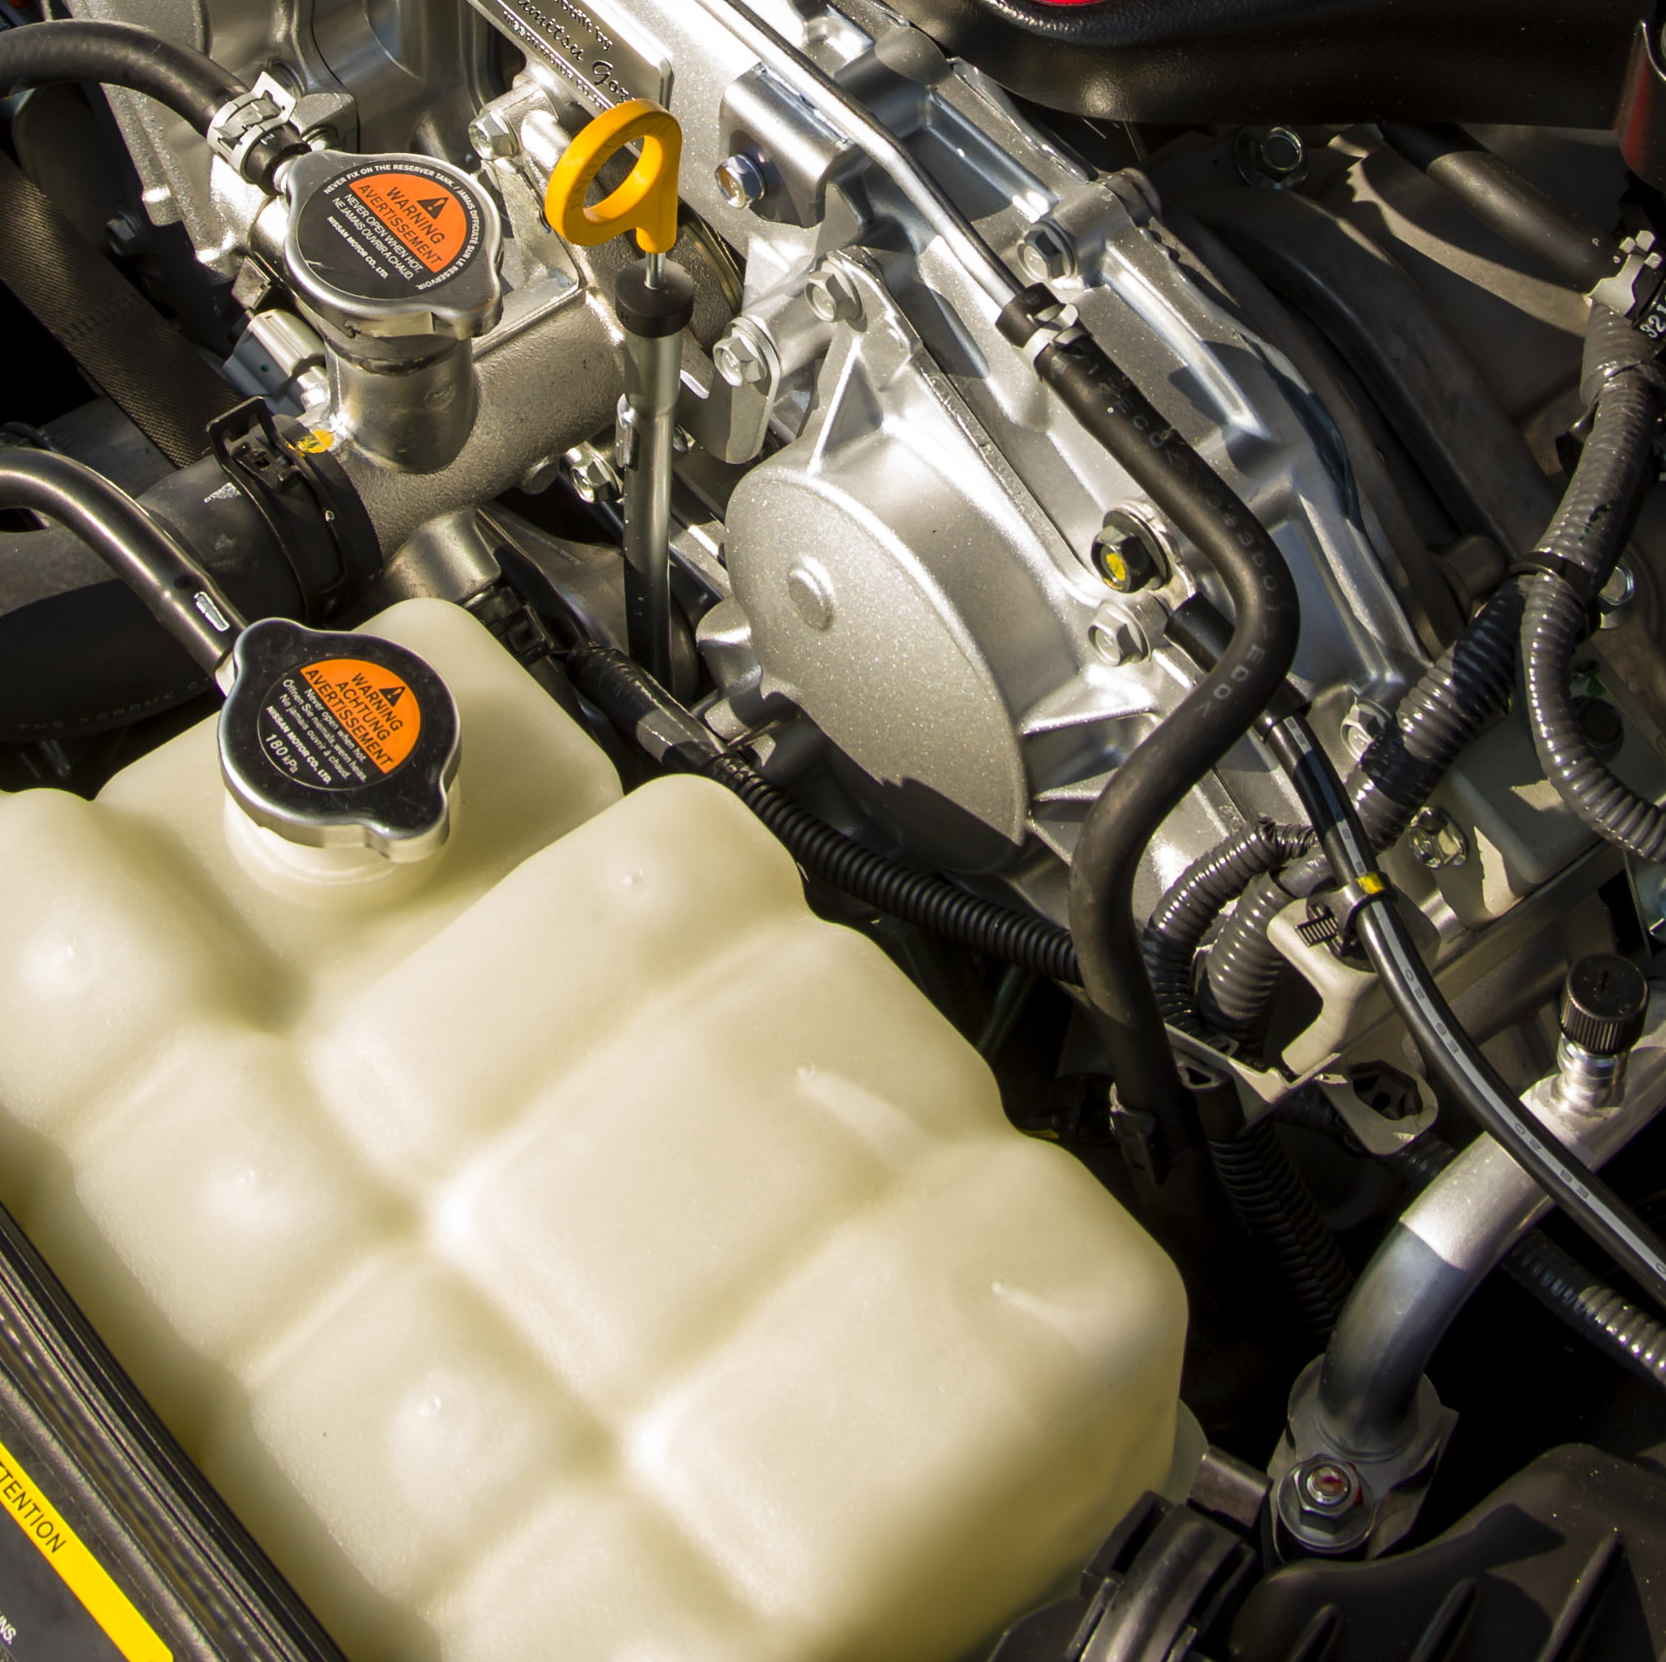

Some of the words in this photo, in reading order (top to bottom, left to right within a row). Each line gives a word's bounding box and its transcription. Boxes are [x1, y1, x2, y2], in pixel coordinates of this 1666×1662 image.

[595, 25, 613, 51] by
[323, 177, 347, 195] NEVER
[346, 171, 360, 180] FIX
[360, 167, 373, 175] ON
[374, 164, 391, 172] THE
[393, 164, 435, 177] RESERVER
[386, 186, 445, 244] WARNING
[456, 189, 475, 210] JAMAIS
[327, 215, 350, 239] NISSAN
[346, 236, 368, 258] MOTOR
[344, 193, 370, 218] NEVER
[366, 216, 388, 237] OPEN
[384, 235, 409, 258] WHEN
[404, 255, 424, 273] HOT.
[358, 184, 443, 265] AVERTISSEMENT
[455, 258, 466, 267] LE
[462, 245, 475, 259] SUR
[279, 694, 291, 707] Ne
[286, 706, 309, 730] jamais
[307, 730, 326, 750] ouvrir
[305, 669, 393, 765] AVERTISSEMENT
[335, 681, 390, 742] ACHTUNG
[351, 672, 403, 732] WARNING
[266, 706, 291, 733] NISSAN
[287, 731, 310, 757] MOTOR
[301, 703, 314, 717] Sie
[334, 743, 352, 763] wenn
[304, 688, 325, 711] Never
[322, 711, 339, 730] open
[337, 729, 355, 749] when
[352, 748, 367, 763] hot.
[265, 734, 288, 756] 180
[282, 753, 299, 774] kPa
